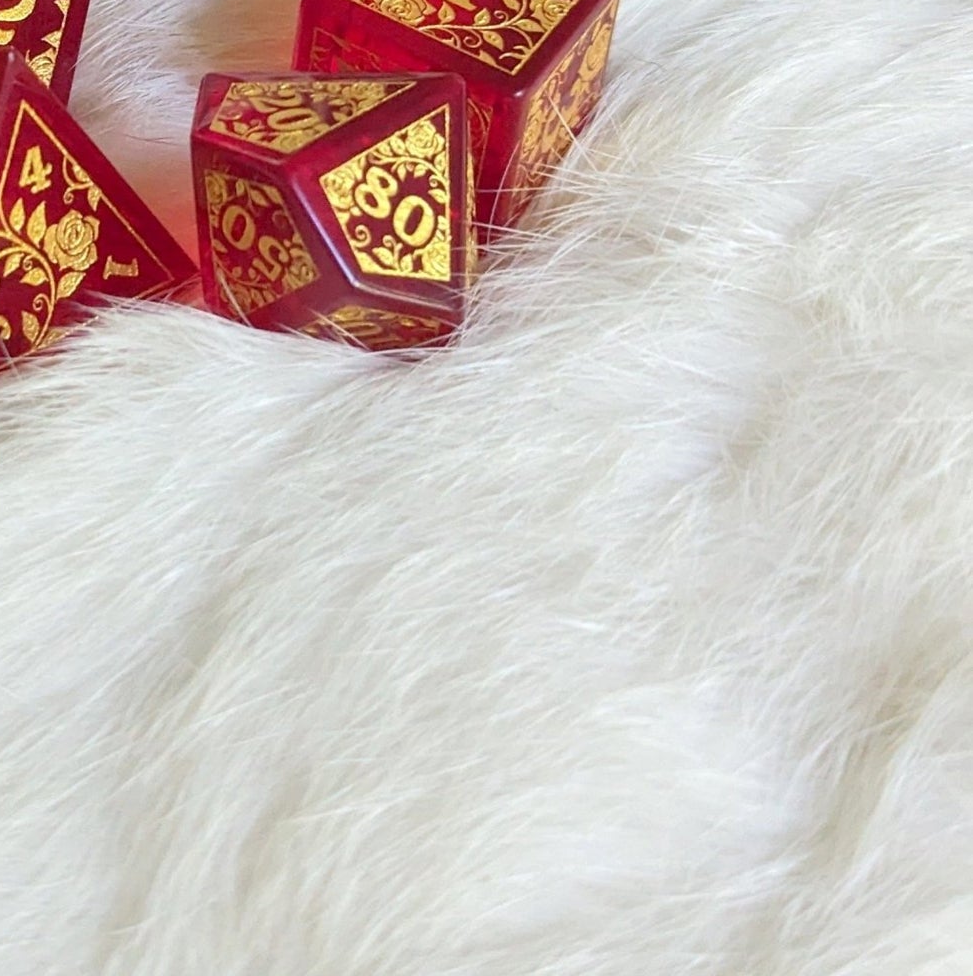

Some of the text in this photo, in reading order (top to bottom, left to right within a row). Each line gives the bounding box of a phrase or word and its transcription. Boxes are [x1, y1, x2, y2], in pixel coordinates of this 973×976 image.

[18, 145, 54, 193] 4
[355, 165, 435, 247] 80
[103, 255, 139, 280] 1
[221, 205, 290, 282] 50
